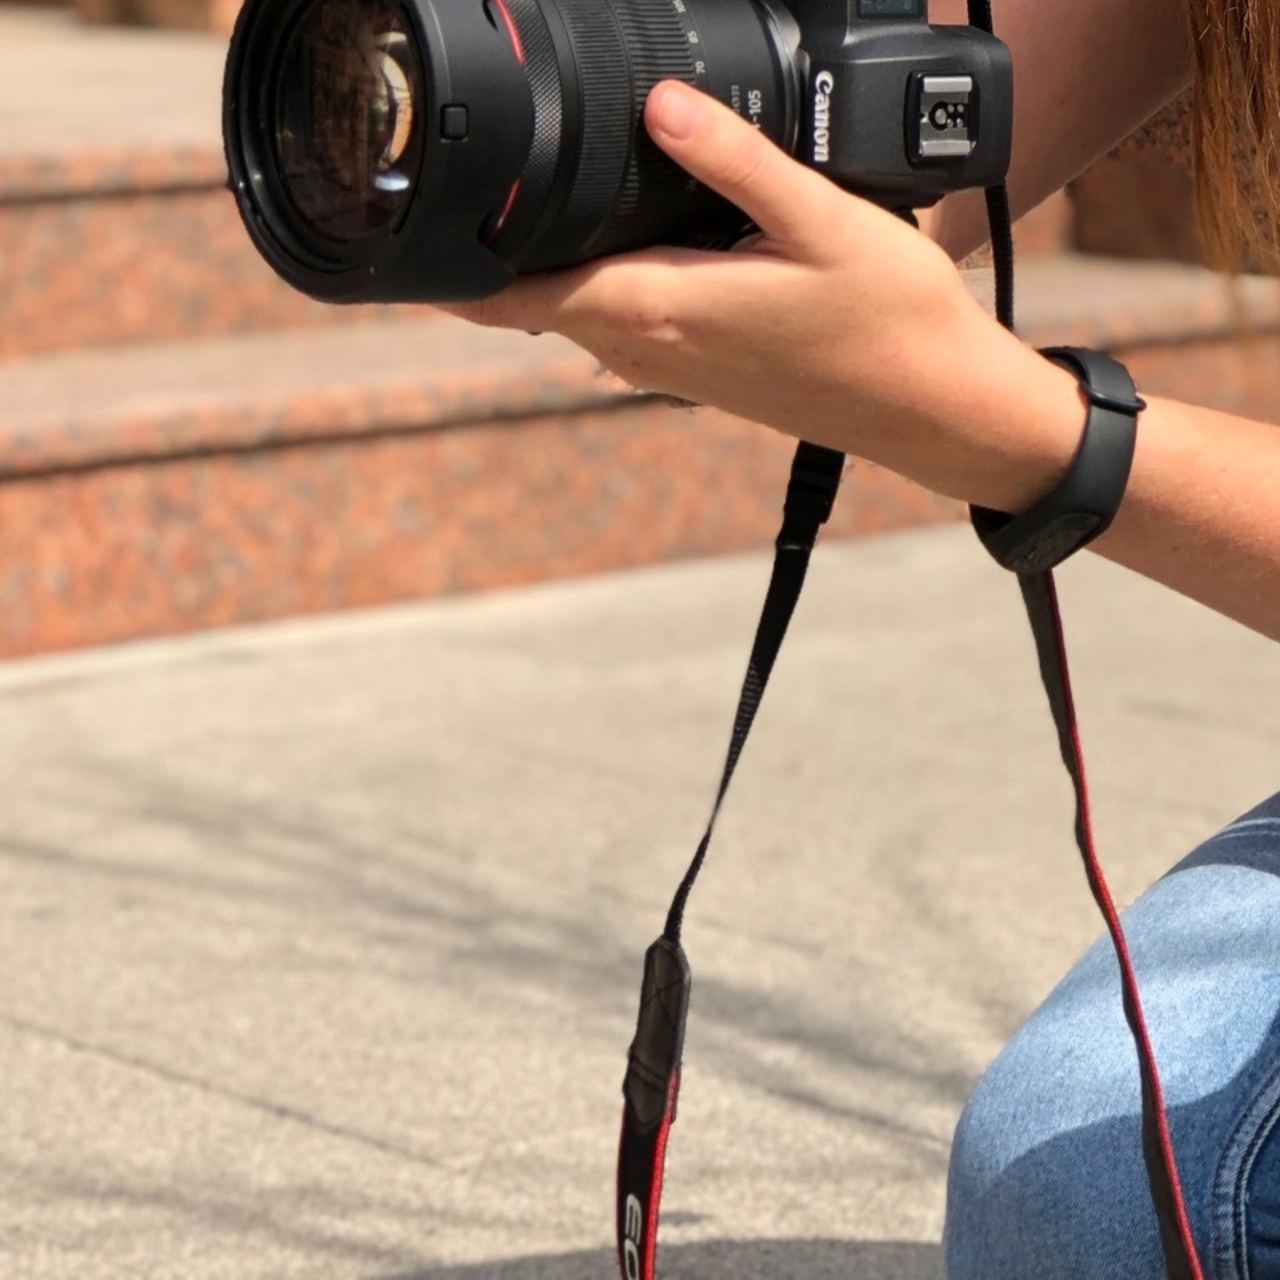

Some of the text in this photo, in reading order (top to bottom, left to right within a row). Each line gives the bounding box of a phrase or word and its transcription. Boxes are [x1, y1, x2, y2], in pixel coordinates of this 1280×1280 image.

[687, 30, 699, 44] 85
[695, 61, 706, 74] 70
[748, 90, 762, 129] -105
[813, 70, 834, 162] Canon
